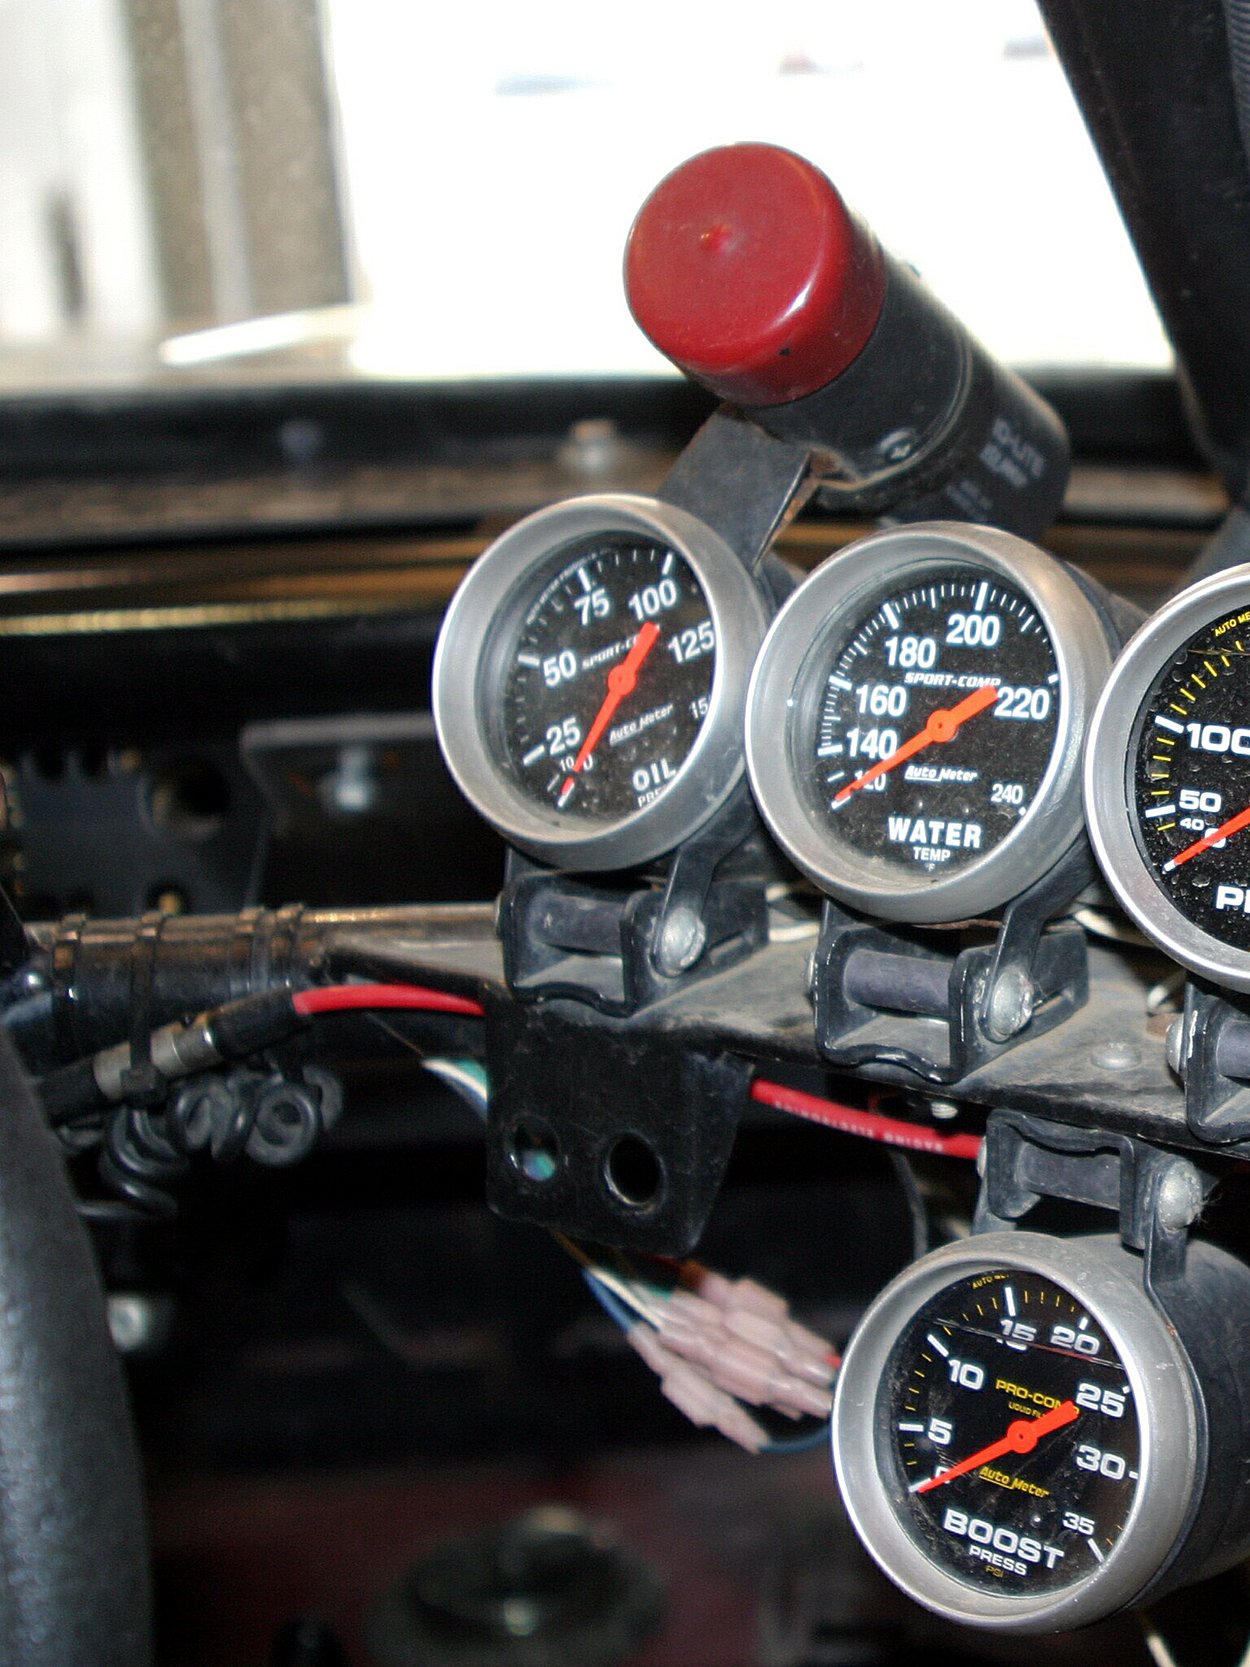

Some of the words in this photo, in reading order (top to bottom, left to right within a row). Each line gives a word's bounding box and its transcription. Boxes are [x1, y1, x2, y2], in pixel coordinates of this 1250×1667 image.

[574, 588, 610, 625] 75
[628, 578, 677, 621] 100
[668, 620, 715, 663] 125
[945, 613, 1000, 646] 200
[1214, 619, 1237, 637] AUTO
[885, 636, 936, 669] 180
[543, 650, 577, 688] 50
[903, 671, 1001, 688] SPORT-COMP
[689, 695, 711, 719] 15
[855, 685, 907, 717] 160
[994, 686, 1050, 720] 220
[546, 717, 581, 756] 25
[609, 721, 637, 746] Auto
[639, 704, 673, 731] Meter
[846, 727, 898, 759] 140
[560, 756, 575, 771] 10
[633, 757, 677, 791] OIL
[905, 765, 937, 782] Auto
[940, 768, 978, 782] Meter
[990, 783, 1024, 805] 240
[1178, 788, 1222, 813] 50
[888, 816, 982, 848] WATER
[1179, 817, 1205, 831] 40
[913, 846, 951, 862] TEMP
[971, 1275, 993, 1290] AUTO
[1000, 1318, 1037, 1343] 15
[1050, 1325, 1100, 1355] 20
[948, 1358, 984, 1391] 10
[1076, 1382, 1126, 1419] 25
[926, 1417, 953, 1446] 5
[1075, 1443, 1126, 1481] 30
[978, 1466, 1013, 1490] Auto
[1010, 1477, 1050, 1498] Meter
[943, 1507, 1065, 1569] BOOST
[1063, 1510, 1095, 1536] 35
[969, 1544, 1028, 1576] PRESS
[985, 1565, 1004, 1579] PSI
